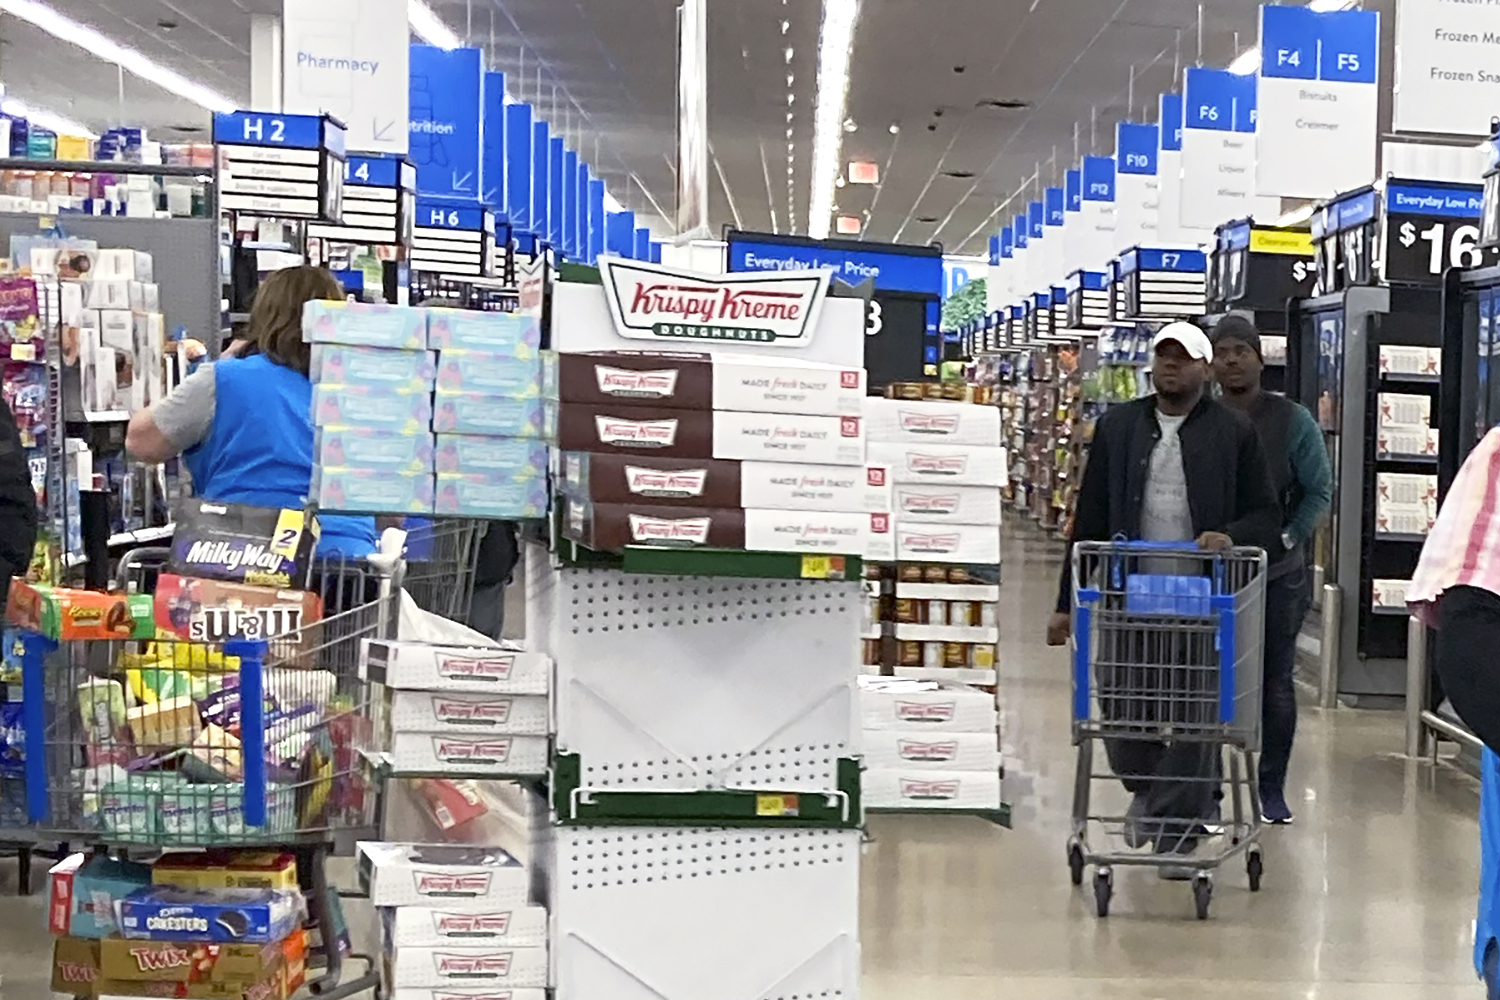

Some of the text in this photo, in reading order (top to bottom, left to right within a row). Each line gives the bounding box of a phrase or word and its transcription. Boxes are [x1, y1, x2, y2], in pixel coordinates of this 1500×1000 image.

[1434, 28, 1478, 43] Frozen
[297, 52, 379, 75] Pharmacy
[1277, 50, 1301, 67] F4
[1337, 54, 1360, 71] F5
[1430, 67, 1474, 82] Frozen
[1200, 105, 1219, 121] F6
[243, 118, 286, 142] H 2
[1126, 153, 1148, 167] F10
[1396, 193, 1443, 209] Everyday
[1445, 196, 1468, 209] Low
[431, 210, 460, 226] H 6
[745, 253, 811, 272] Everyday
[845, 261, 880, 278] Price
[1162, 253, 1181, 268] F7
[630, 282, 804, 322] Krispy Kreme
[660, 323, 770, 341] DOUGHNUTS
[278, 529, 298, 549] 2
[186, 540, 284, 574] Milky Way
[130, 945, 191, 972] Twix
